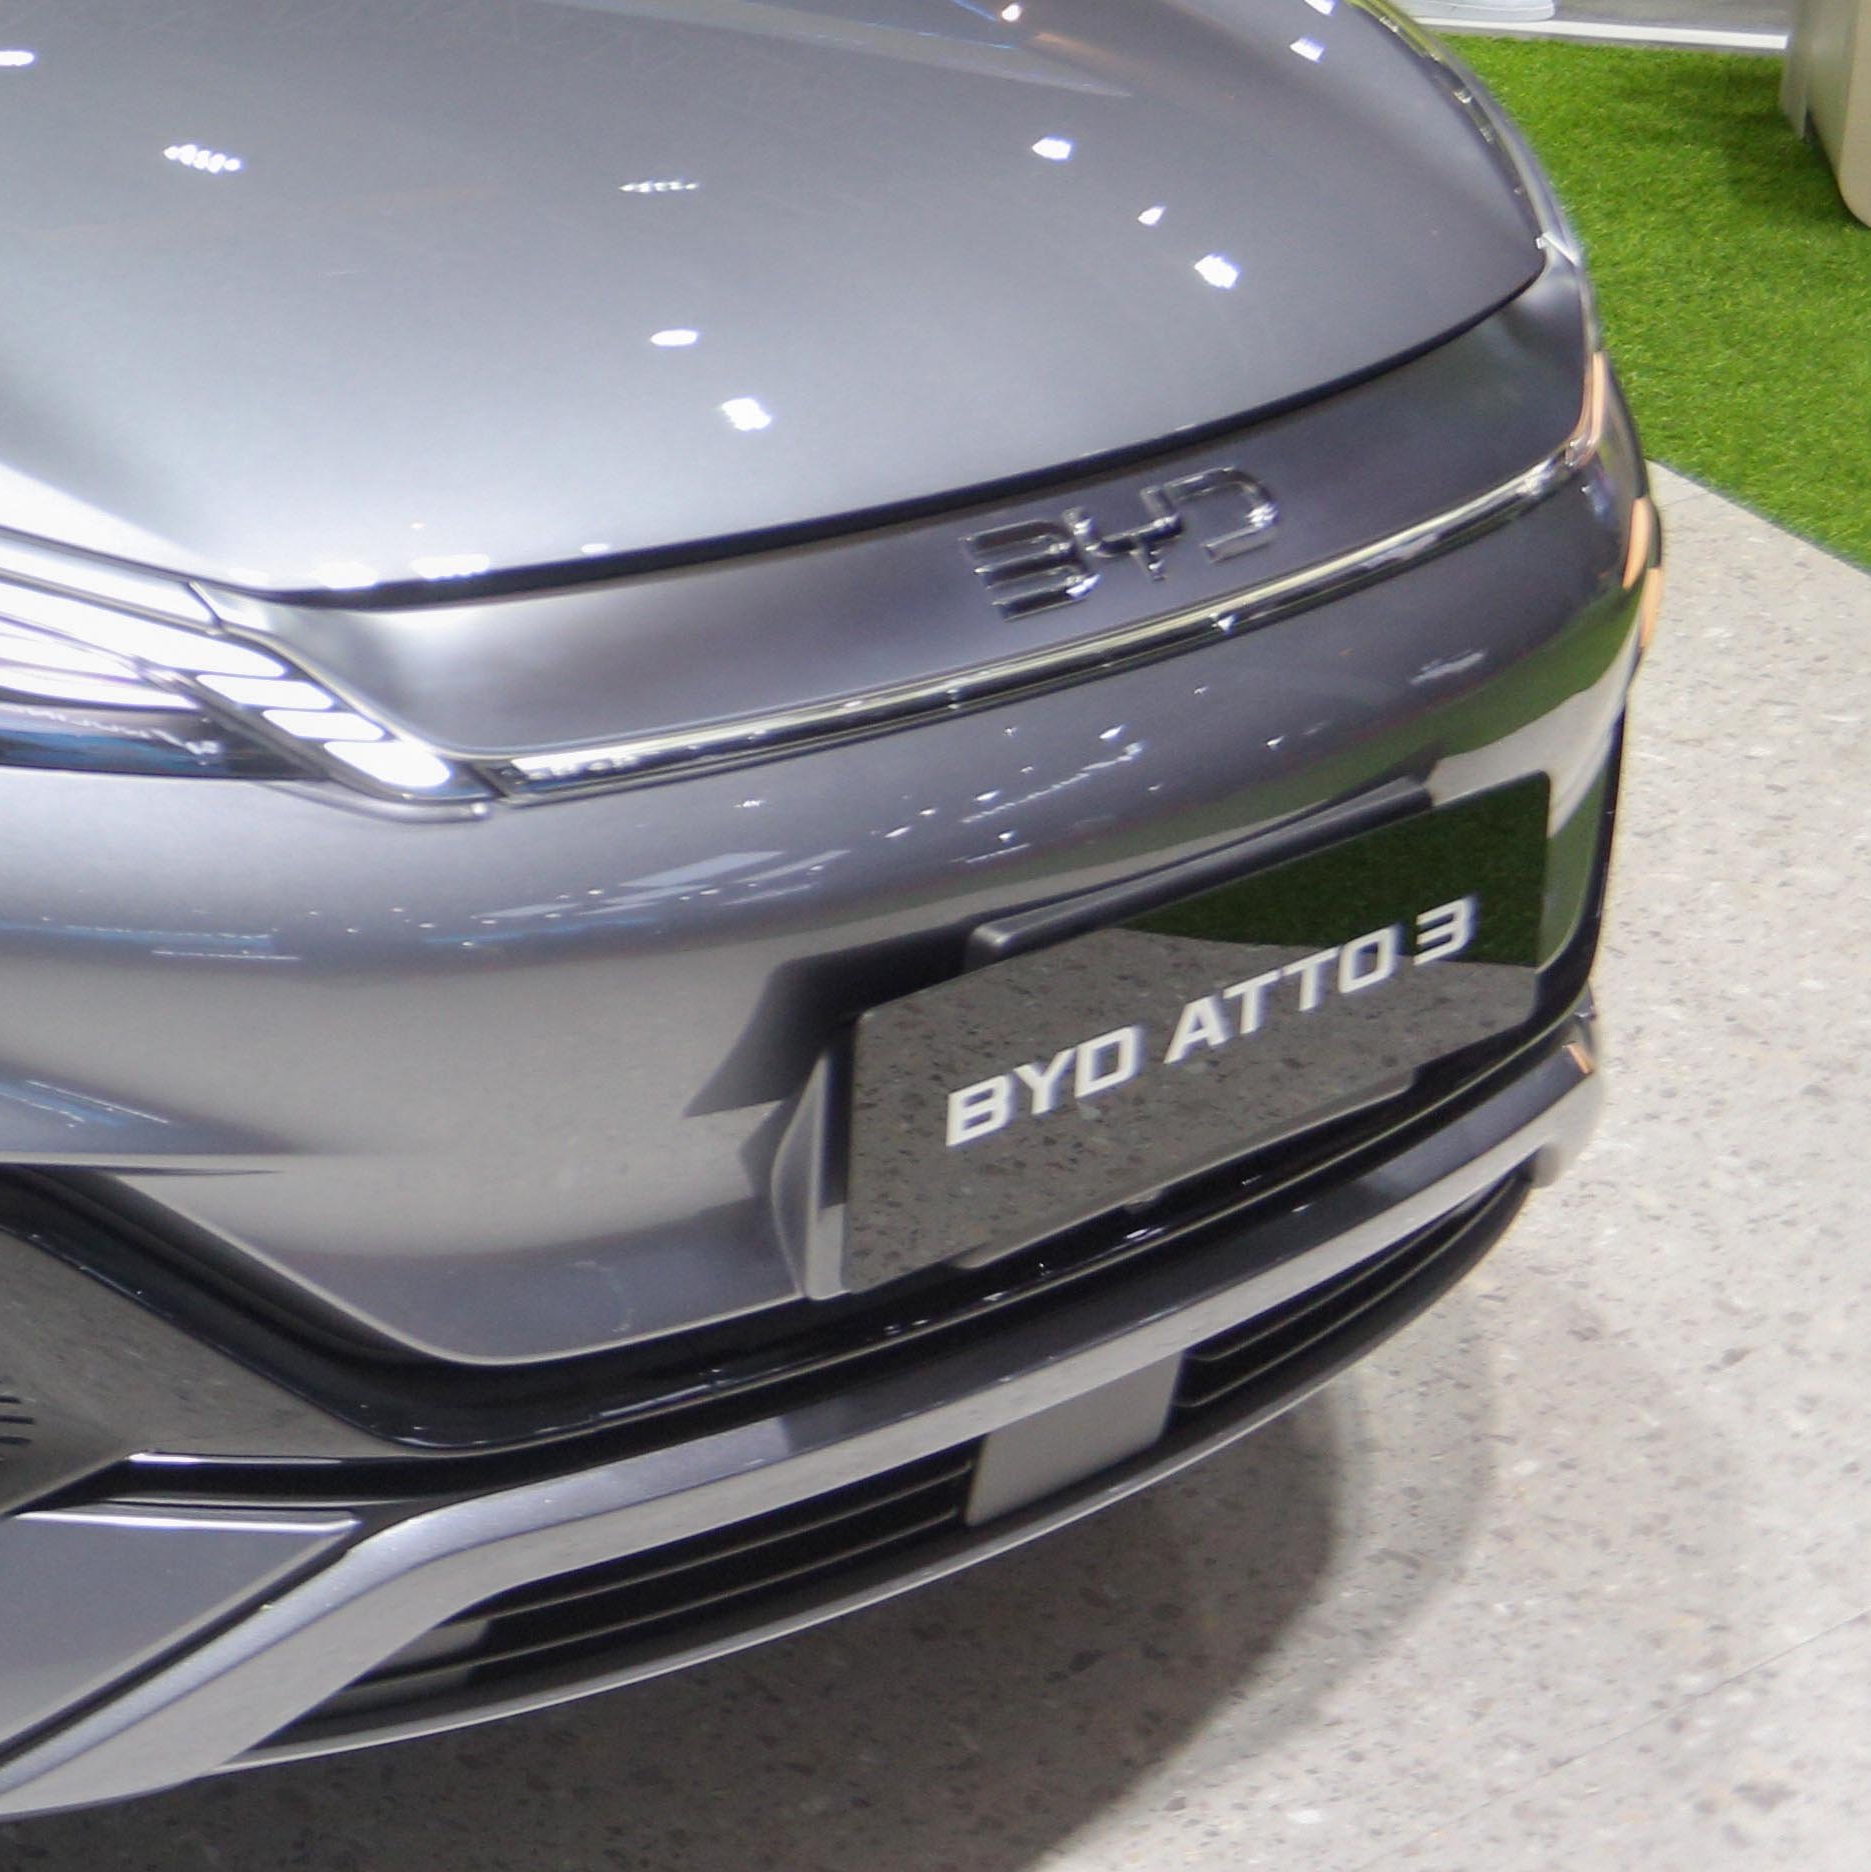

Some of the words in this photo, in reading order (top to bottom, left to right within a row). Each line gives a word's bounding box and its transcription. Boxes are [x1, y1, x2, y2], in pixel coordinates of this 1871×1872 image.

[960, 467, 1278, 621] BYD
[946, 1024, 1141, 1147] BYD
[1164, 926, 1399, 1066] ATTO
[1413, 897, 1477, 966] 3
